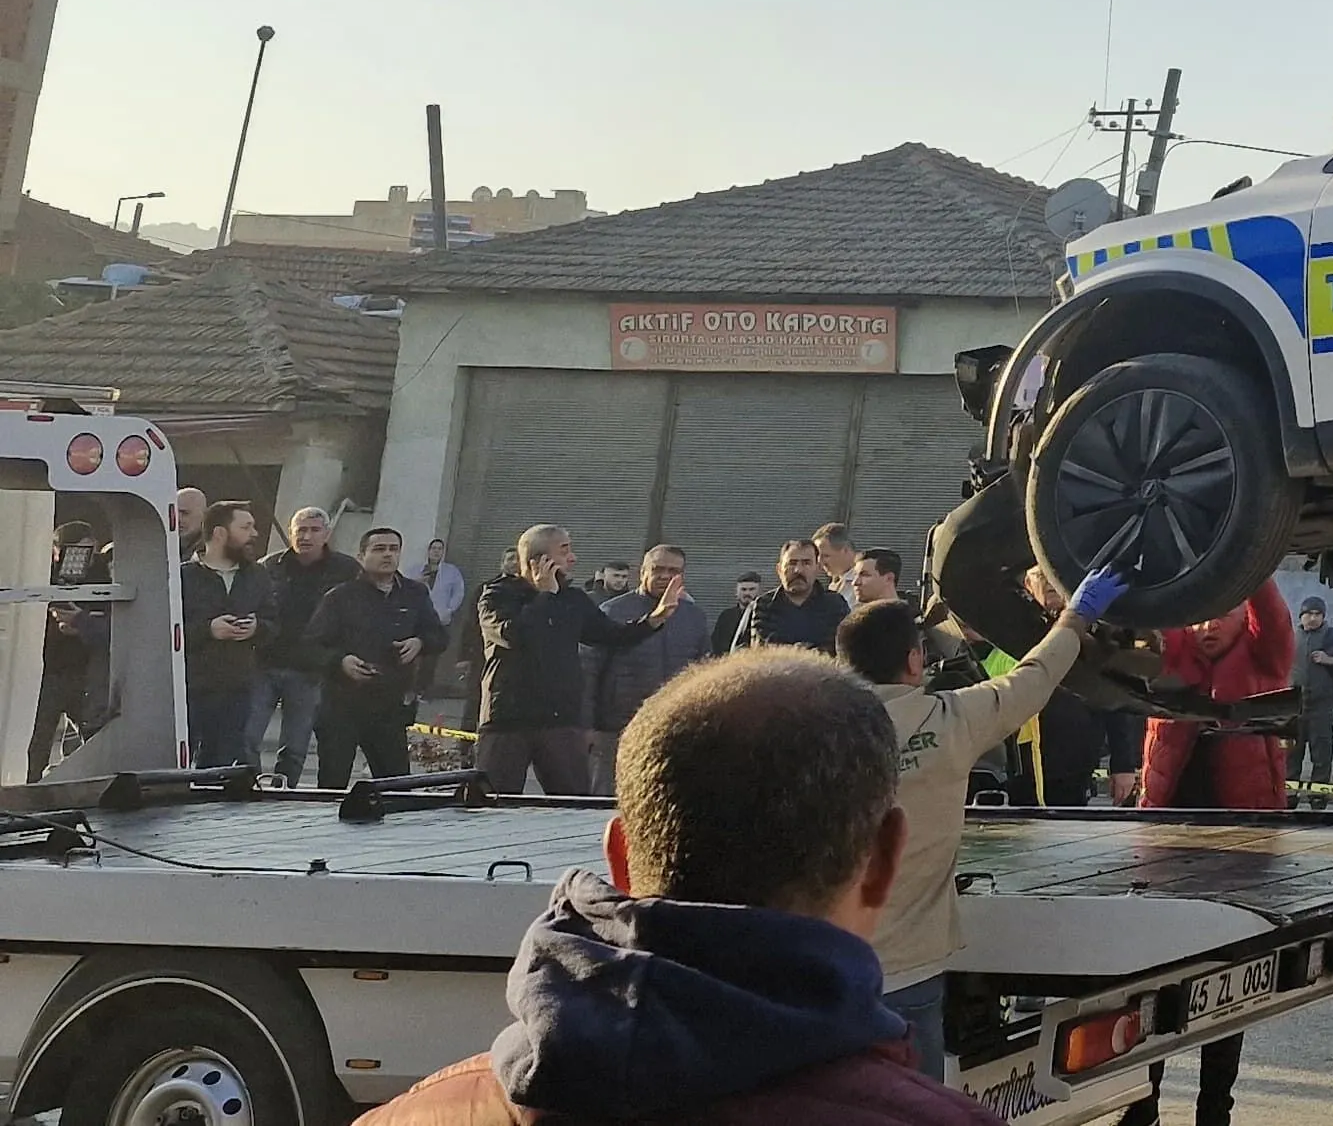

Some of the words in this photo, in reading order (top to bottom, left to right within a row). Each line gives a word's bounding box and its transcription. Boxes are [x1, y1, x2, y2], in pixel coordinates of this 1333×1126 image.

[703, 311, 756, 332] OTO
[765, 311, 888, 334] KAPORTA
[1189, 979, 1209, 1015] 45
[1216, 972, 1233, 1006] ZL
[1242, 960, 1271, 995] 003
